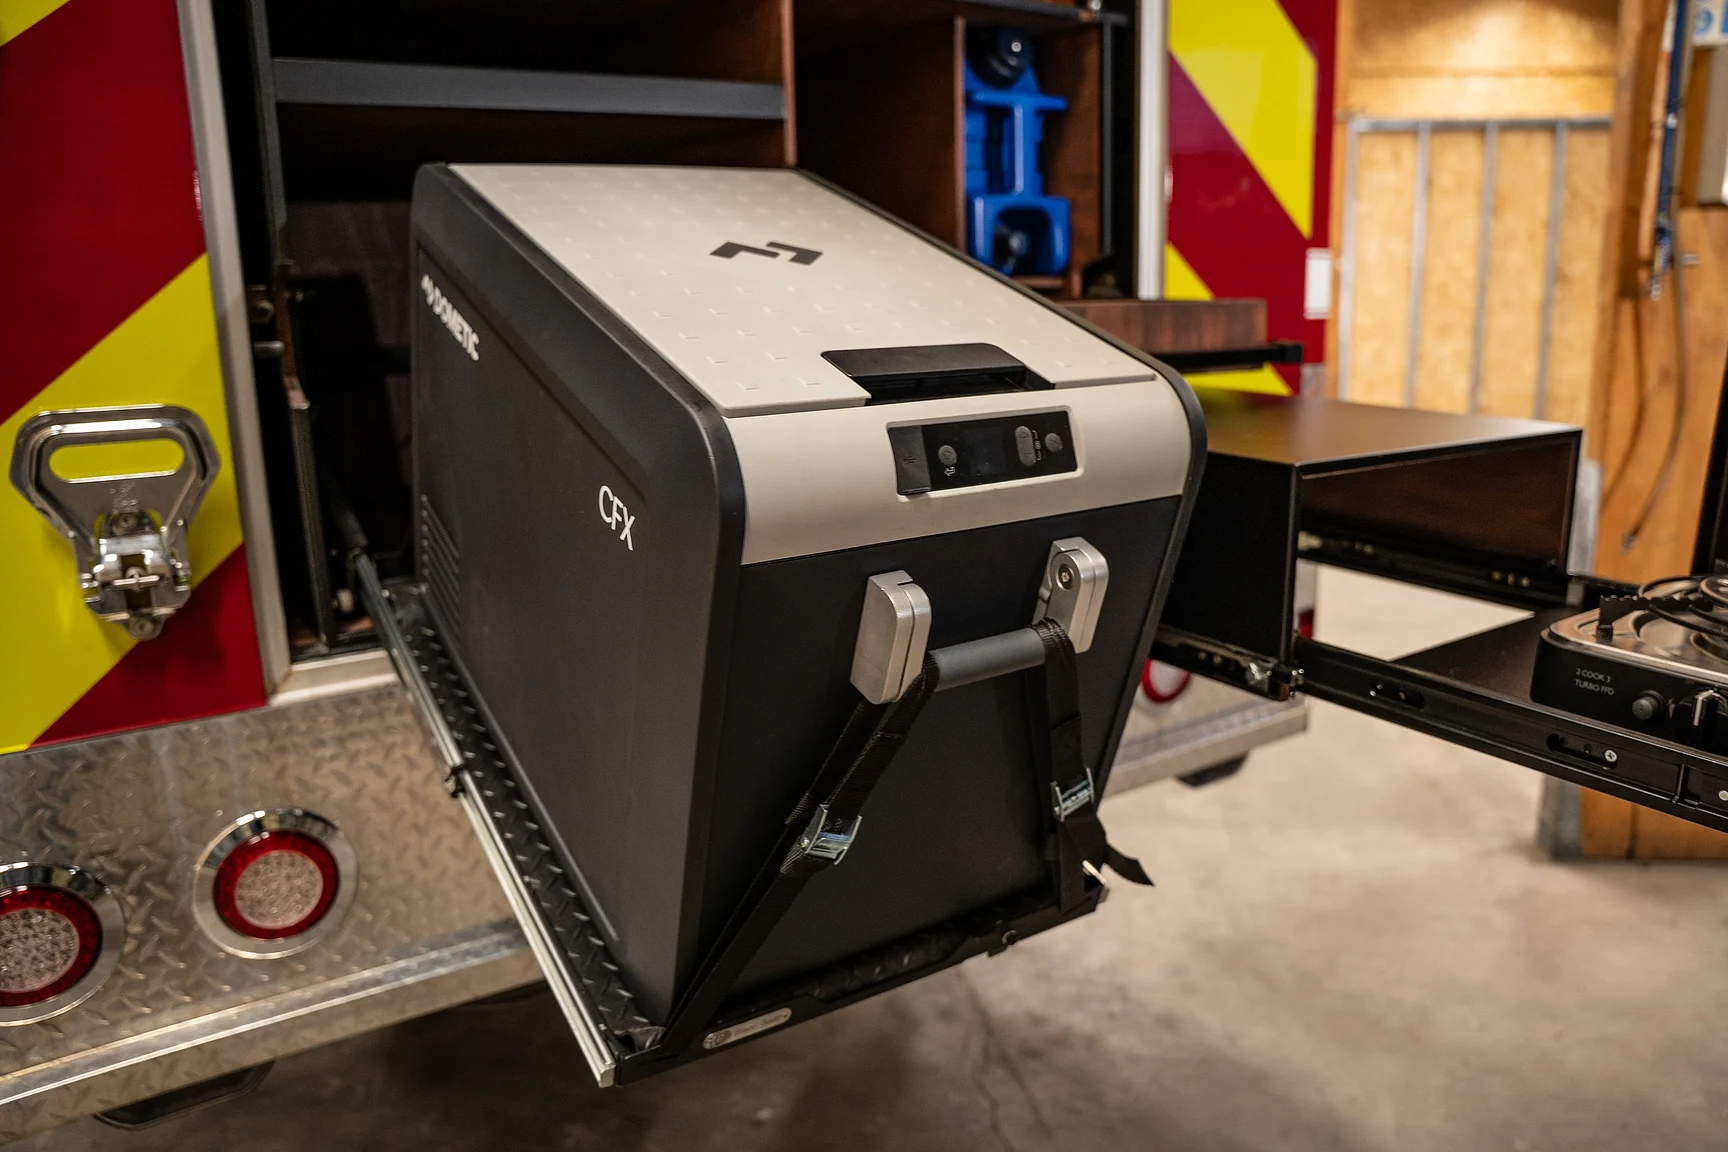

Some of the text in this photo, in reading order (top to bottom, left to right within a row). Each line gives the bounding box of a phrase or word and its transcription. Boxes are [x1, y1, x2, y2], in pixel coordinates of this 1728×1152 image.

[432, 286, 480, 361] DOMETIC
[598, 485, 635, 551] CFX
[1575, 678, 1600, 691] TURBO
[1582, 669, 1605, 682] COOK
